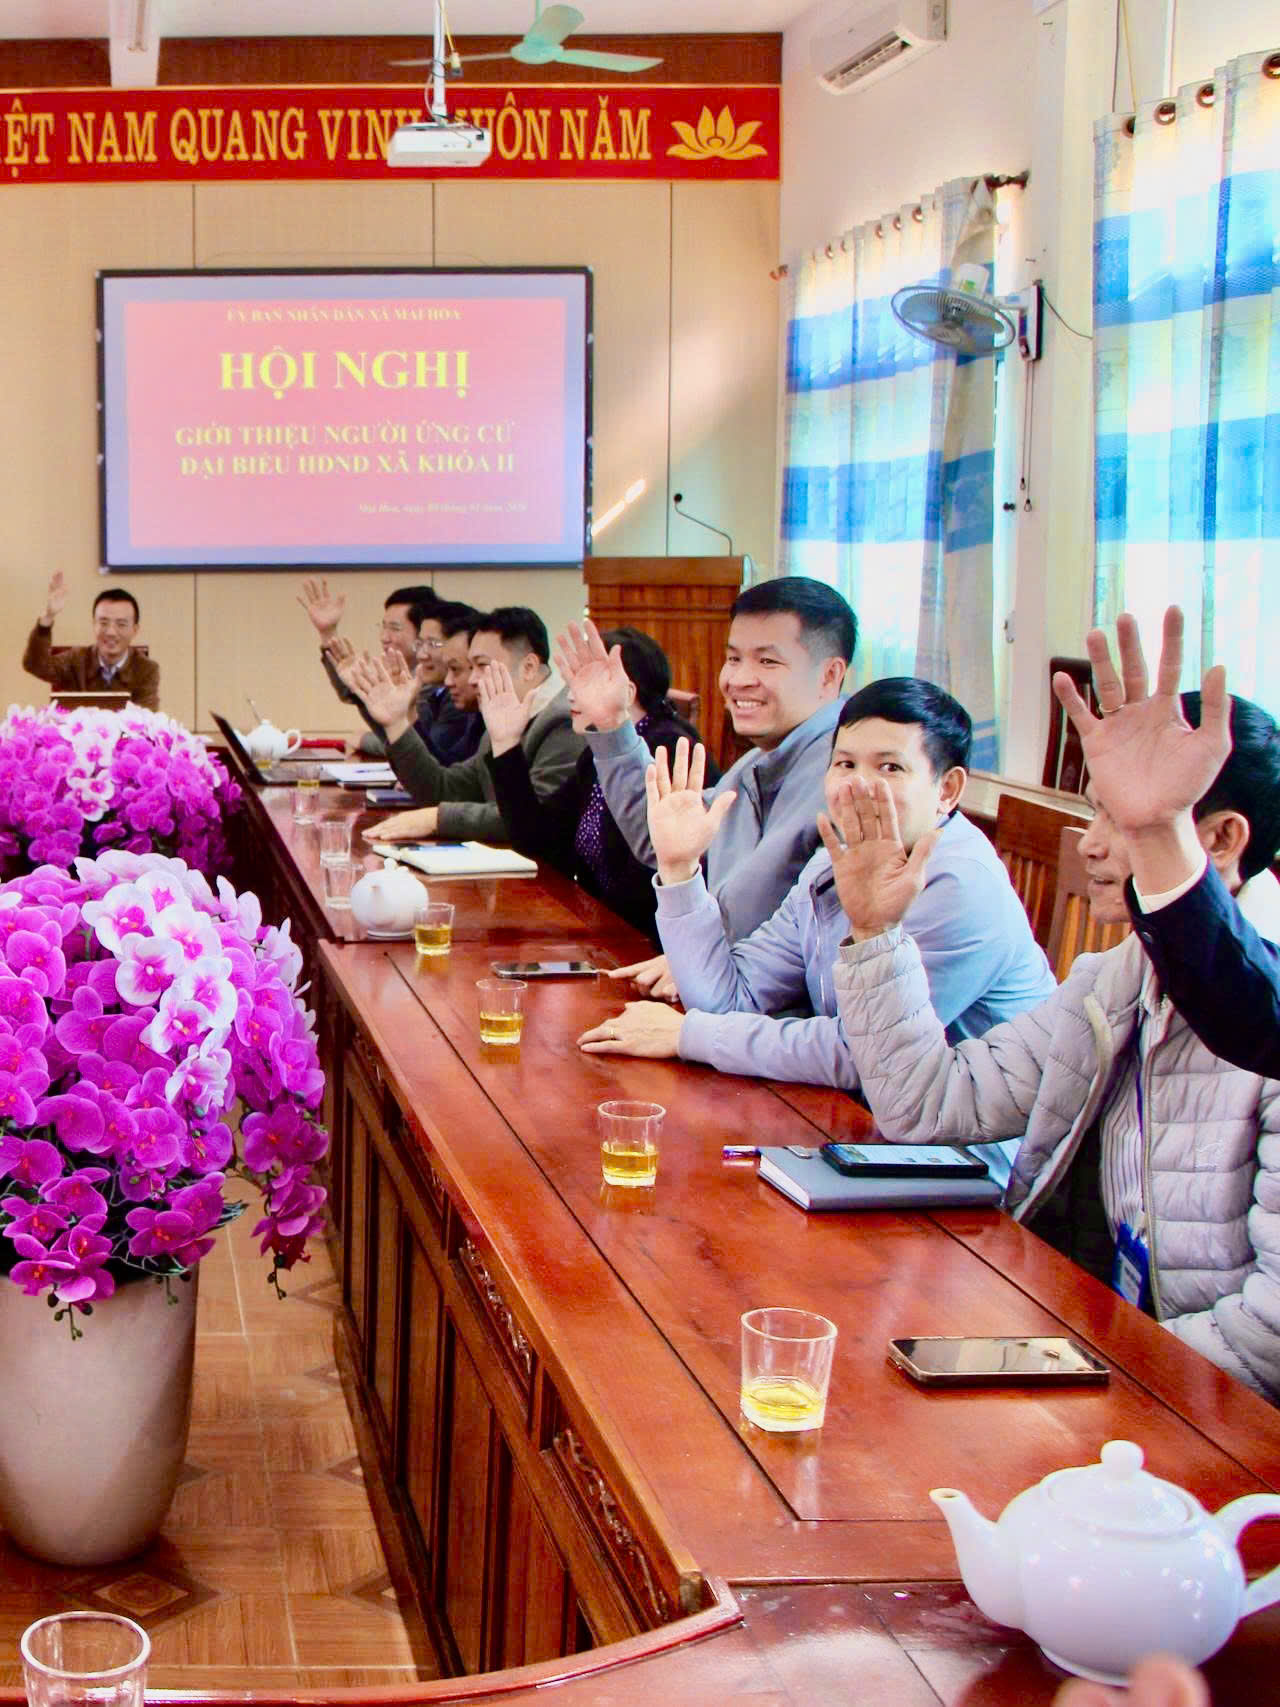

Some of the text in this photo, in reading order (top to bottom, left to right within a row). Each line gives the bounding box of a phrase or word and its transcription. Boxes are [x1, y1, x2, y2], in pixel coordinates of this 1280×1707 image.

[68, 112, 157, 163] NAM
[170, 108, 307, 165] QUANG
[559, 95, 652, 161] NĂM
[220, 345, 470, 400] HỘI NGHỊ
[377, 449, 410, 474] XÃ
